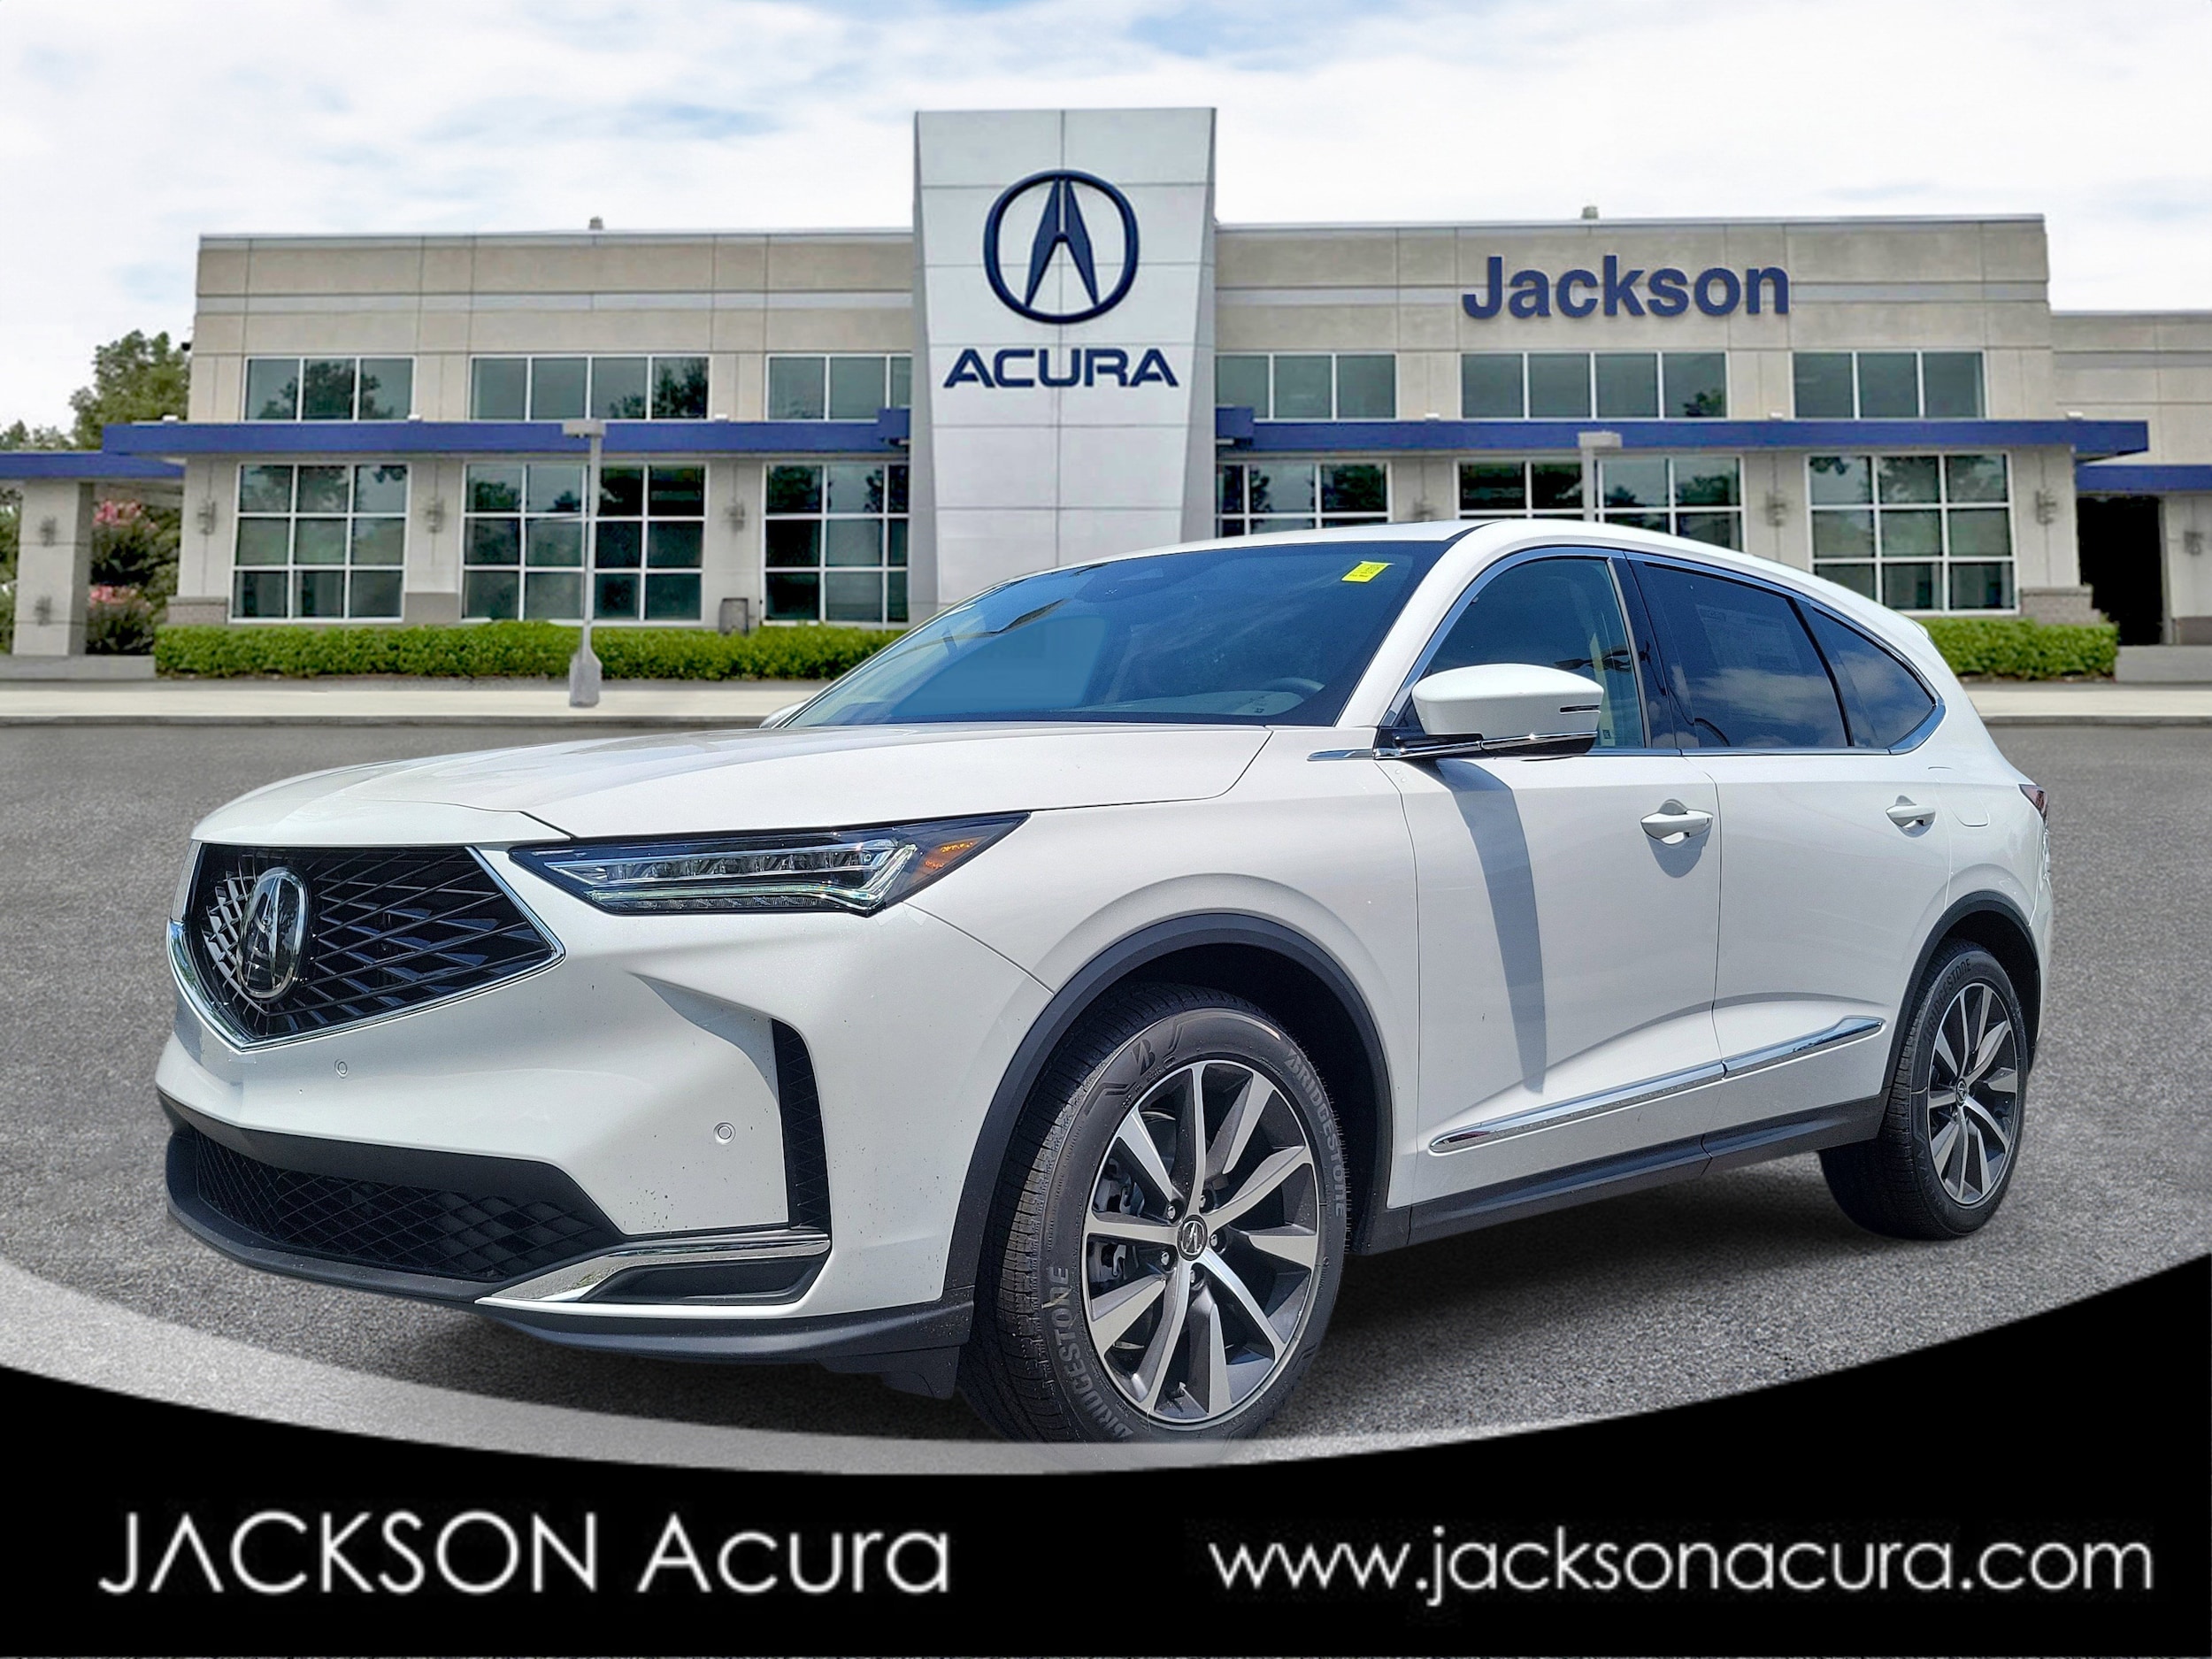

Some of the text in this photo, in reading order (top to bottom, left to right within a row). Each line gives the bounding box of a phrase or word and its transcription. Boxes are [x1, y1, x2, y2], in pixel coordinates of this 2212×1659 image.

[1463, 256, 1789, 319] Jackson
[943, 348, 1179, 388] ACURA
[1284, 1048, 1346, 1217] BRIDGESTONE
[1048, 1266, 1133, 1439] BRIDGESTONE
